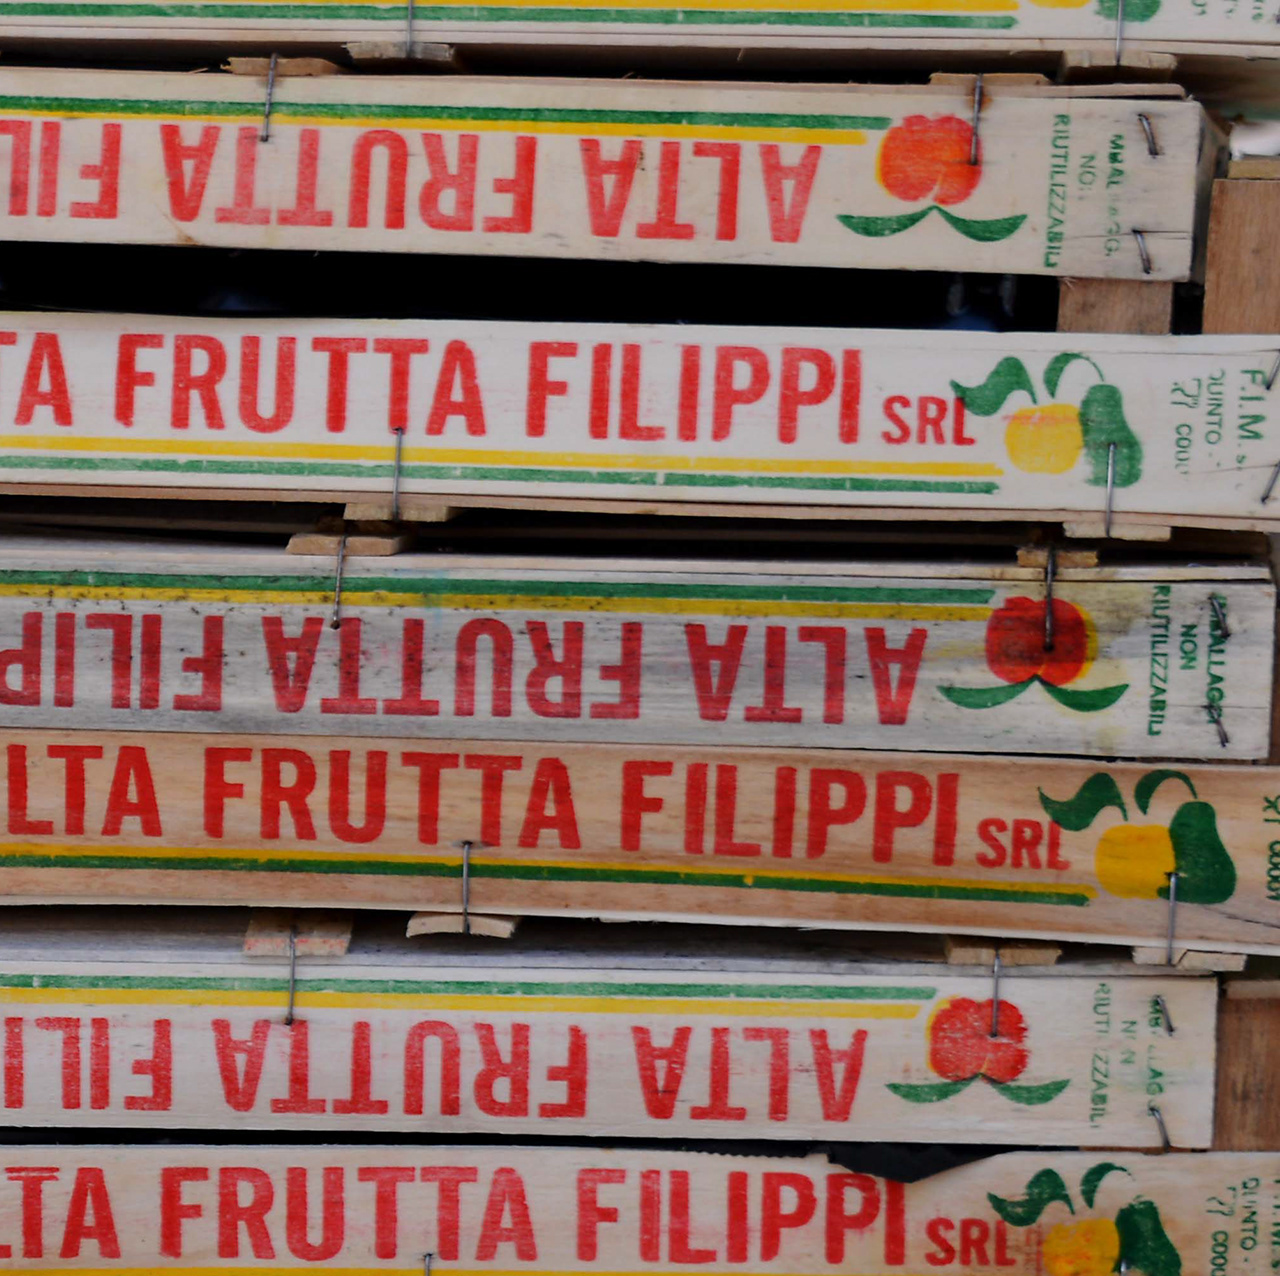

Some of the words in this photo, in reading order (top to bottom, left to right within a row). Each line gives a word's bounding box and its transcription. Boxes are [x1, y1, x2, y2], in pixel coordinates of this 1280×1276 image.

[160, 124, 538, 234] FRUTTA
[579, 138, 822, 243] ALTA
[115, 333, 487, 436] FRUTTA
[526, 341, 862, 444] FILIPPI
[882, 395, 976, 446] SRL
[262, 616, 643, 719] FRUTTA
[685, 624, 928, 724] ALTA
[1179, 623, 1198, 671] NON
[205, 747, 580, 848] FRUTTA
[622, 761, 958, 866] FILIPPI
[978, 819, 1069, 870] SRL
[212, 1019, 589, 1118] FRUTTA
[632, 1026, 868, 1122] ALTA
[161, 1166, 537, 1261] FRUTTA
[578, 1168, 906, 1266] FILIPPI
[925, 1217, 1017, 1267] SRL
